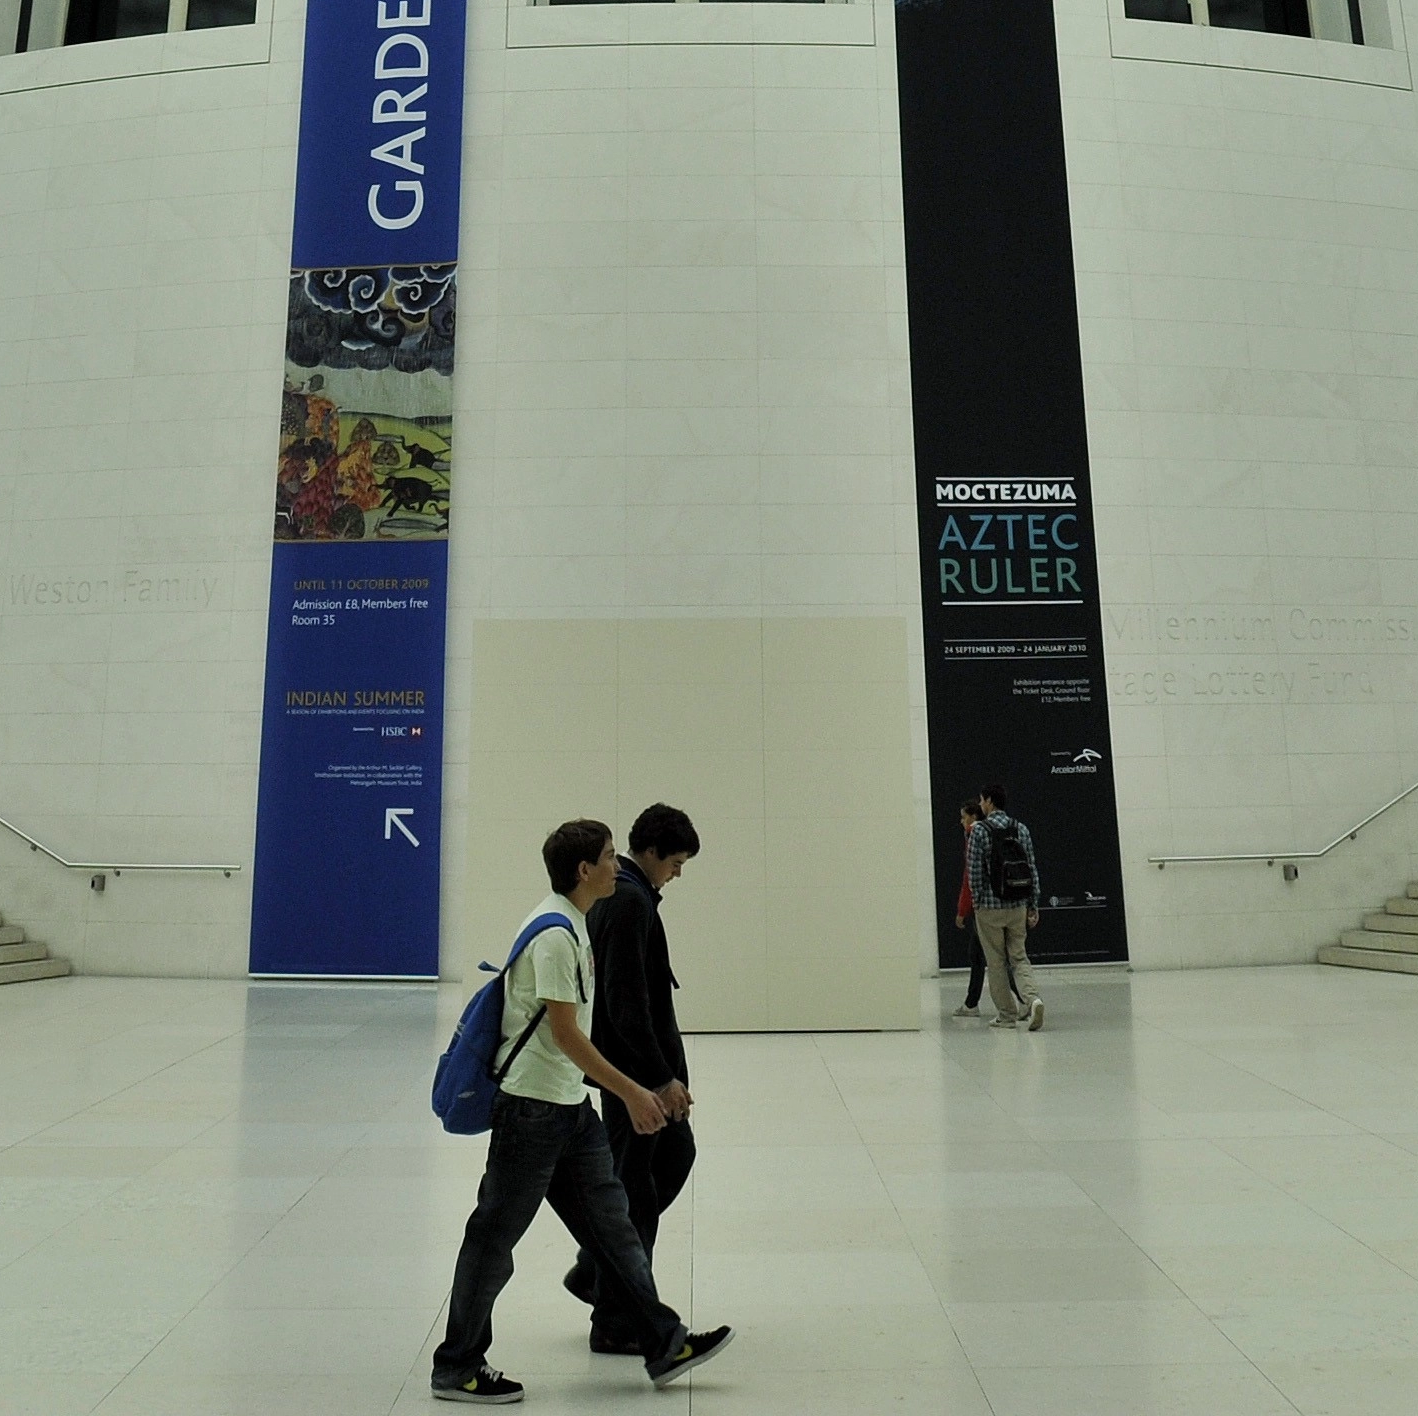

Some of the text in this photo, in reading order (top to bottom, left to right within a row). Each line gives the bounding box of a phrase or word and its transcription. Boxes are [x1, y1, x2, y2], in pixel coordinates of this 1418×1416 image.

[935, 483, 1077, 501] MOCTEZUMA
[938, 513, 1080, 551] AZTEC
[941, 557, 1082, 594] RULER
[10, 572, 108, 606] Weston
[122, 569, 219, 608] Family
[293, 578, 430, 591] UNTIL 11 OCTOBER 2009
[292, 599, 342, 610] Admission
[361, 598, 407, 609] Members
[409, 597, 429, 608] free
[291, 614, 336, 625] Room 35
[944, 645, 954, 654] 24
[955, 645, 996, 654] SEPTEMBER
[997, 644, 1016, 653] 2009
[1023, 644, 1033, 653] 24
[1034, 644, 1066, 654] JANUARY
[1068, 644, 1087, 653] 2010
[1191, 663, 1296, 702] Lottery
[286, 690, 425, 706] INDIAN SUMMER
